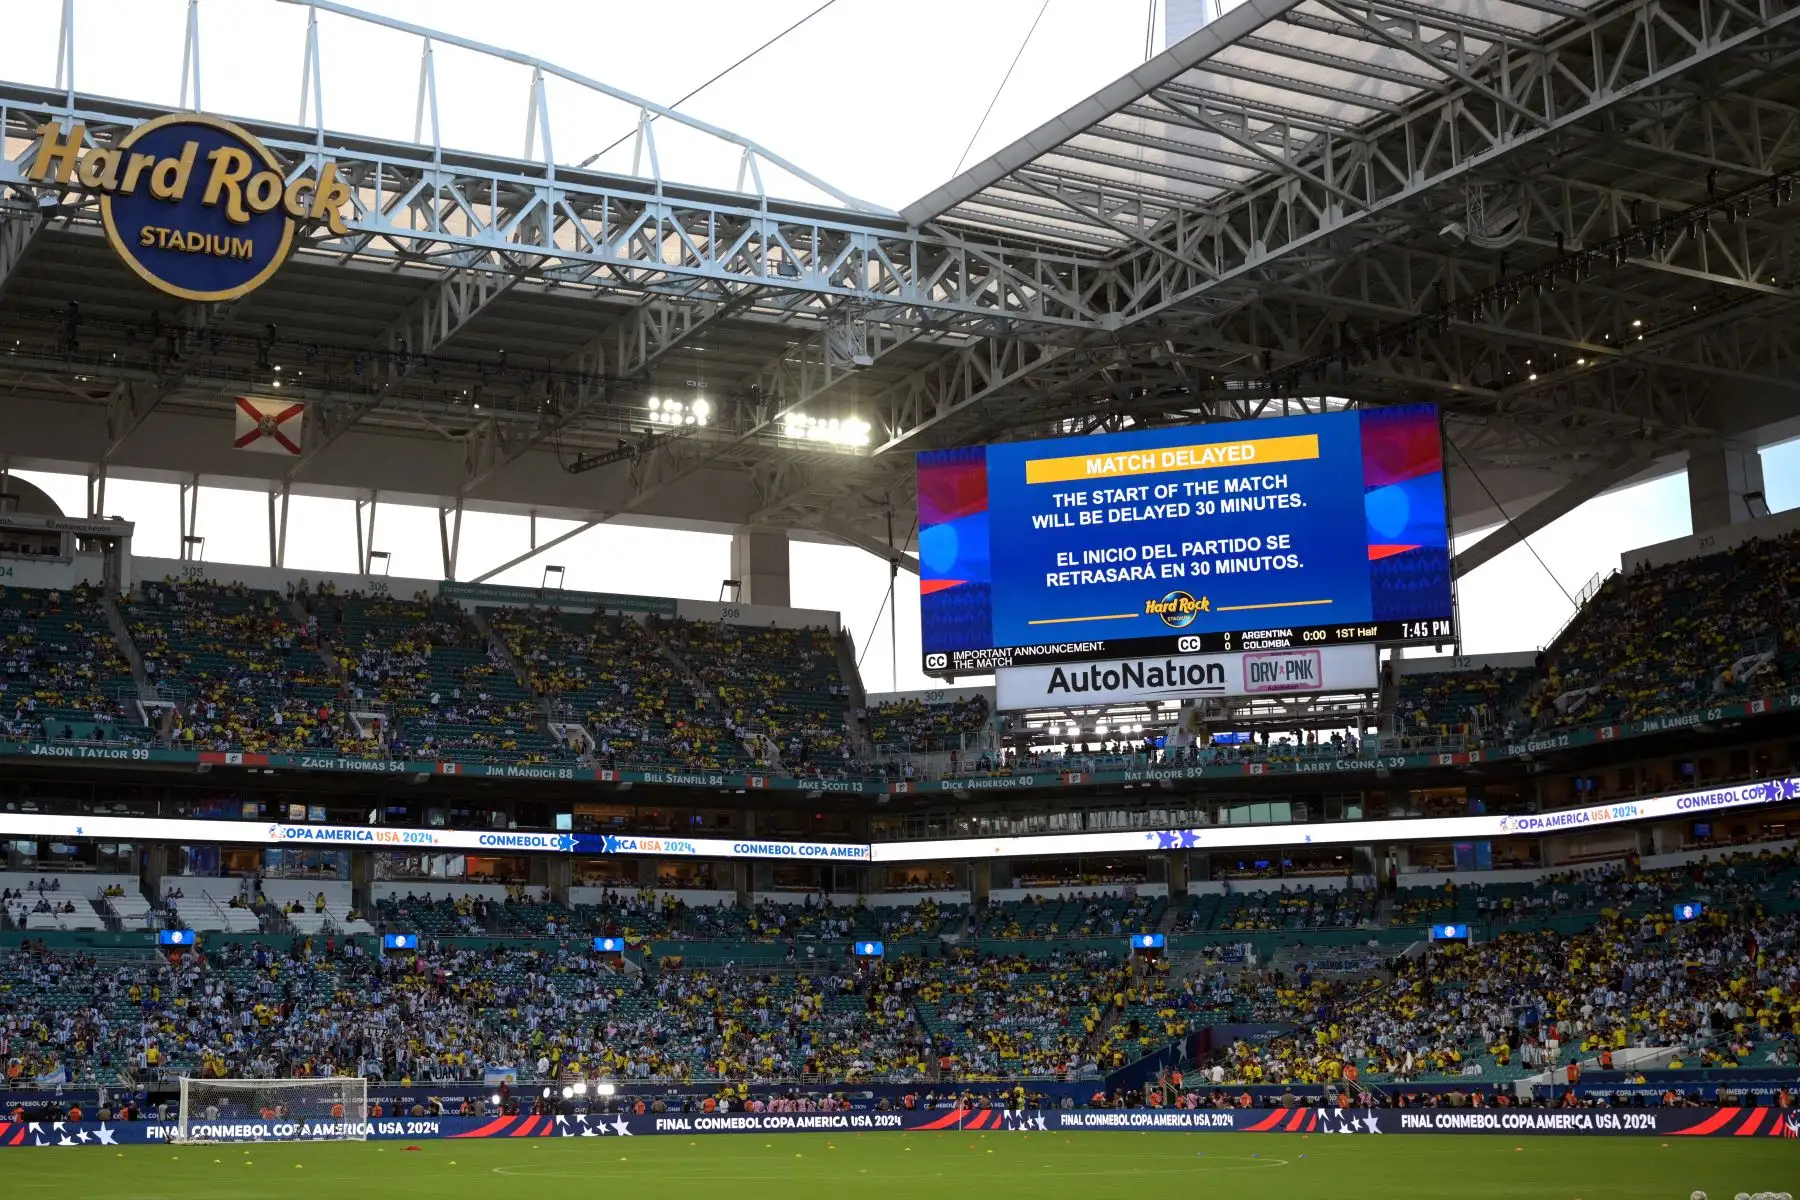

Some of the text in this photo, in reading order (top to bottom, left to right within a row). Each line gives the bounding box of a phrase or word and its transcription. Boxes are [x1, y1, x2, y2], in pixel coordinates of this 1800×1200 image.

[29, 121, 350, 235] Hard Rock
[140, 225, 254, 260] STADIUM
[1086, 444, 1256, 475] MATCH DELAYED
[1053, 474, 1288, 508] THE START OF THE MATCH
[1032, 493, 1307, 529] WILL BE DELAYED 30 MINUTES.
[1057, 534, 1291, 567] EL INICIO DEL PARTIDO SE
[181, 566, 204, 581] 305
[1046, 554, 1304, 587] RETRASARÁ EN 30 MINUTOS.
[368, 581, 388, 593] 306
[1145, 595, 1210, 614] Hard Rock
[722, 607, 740, 619] 308
[1224, 629, 1294, 641] 0 ARGENTINA
[1303, 627, 1378, 641] 0:00 1ST Half
[1401, 620, 1450, 638] 7:45 PM
[953, 641, 1106, 661] IMPORTANT ANNOUNCEMENT.
[1181, 639, 1198, 650] CC
[1225, 639, 1291, 651] 0 COLOMBIA
[927, 655, 945, 667] CC
[953, 657, 1013, 669] THE MATCH
[1046, 659, 1226, 694] AutoNation
[1250, 659, 1314, 683] DRV PNK
[924, 691, 944, 702] 309
[1642, 708, 1723, 733] JIM LANGER 62
[31, 744, 149, 760] JASON TAYLOR 99
[1508, 735, 1570, 756] BOB GRIESE 12
[301, 757, 406, 772] ZACH THOMAS 54
[486, 764, 573, 779] JIM MANDICH 88
[1295, 756, 1406, 773] LARRY CSONKA 39
[644, 772, 723, 786] BILL STANFILL 84
[1124, 767, 1203, 781] NAT MOORE 89
[797, 779, 863, 792] JAKE SCOTT 13
[941, 776, 1034, 791] DICK ANDERSON 40
[1676, 788, 1765, 811] CONMEBOL COP
[1545, 813, 1590, 829] AMERICA
[1591, 809, 1611, 821] USA
[1613, 805, 1637, 819] 2024
[315, 828, 374, 842] AMERICA
[377, 830, 400, 842] USA
[403, 831, 433, 844] 2024
[479, 834, 548, 848] CONMEBOL
[639, 839, 661, 851] USA
[664, 840, 692, 852] 2024
[733, 843, 865, 858] CONMEBOL COPA AMERI
[656, 1113, 902, 1131] FINAL CONMEBOL COPA AMERICA USA 2024
[1061, 1113, 1234, 1127] FINAL CONMEBOL COPA AMERICA USA 2024
[1401, 1114, 1656, 1129] FINAL CONMEBOL COPA AMERICA USA 2024
[191, 1125, 279, 1138] CONMEBOL
[279, 1123, 311, 1138] COPA
[312, 1122, 376, 1136] AMERICA
[379, 1121, 405, 1135] USA
[407, 1121, 440, 1135] 2024
